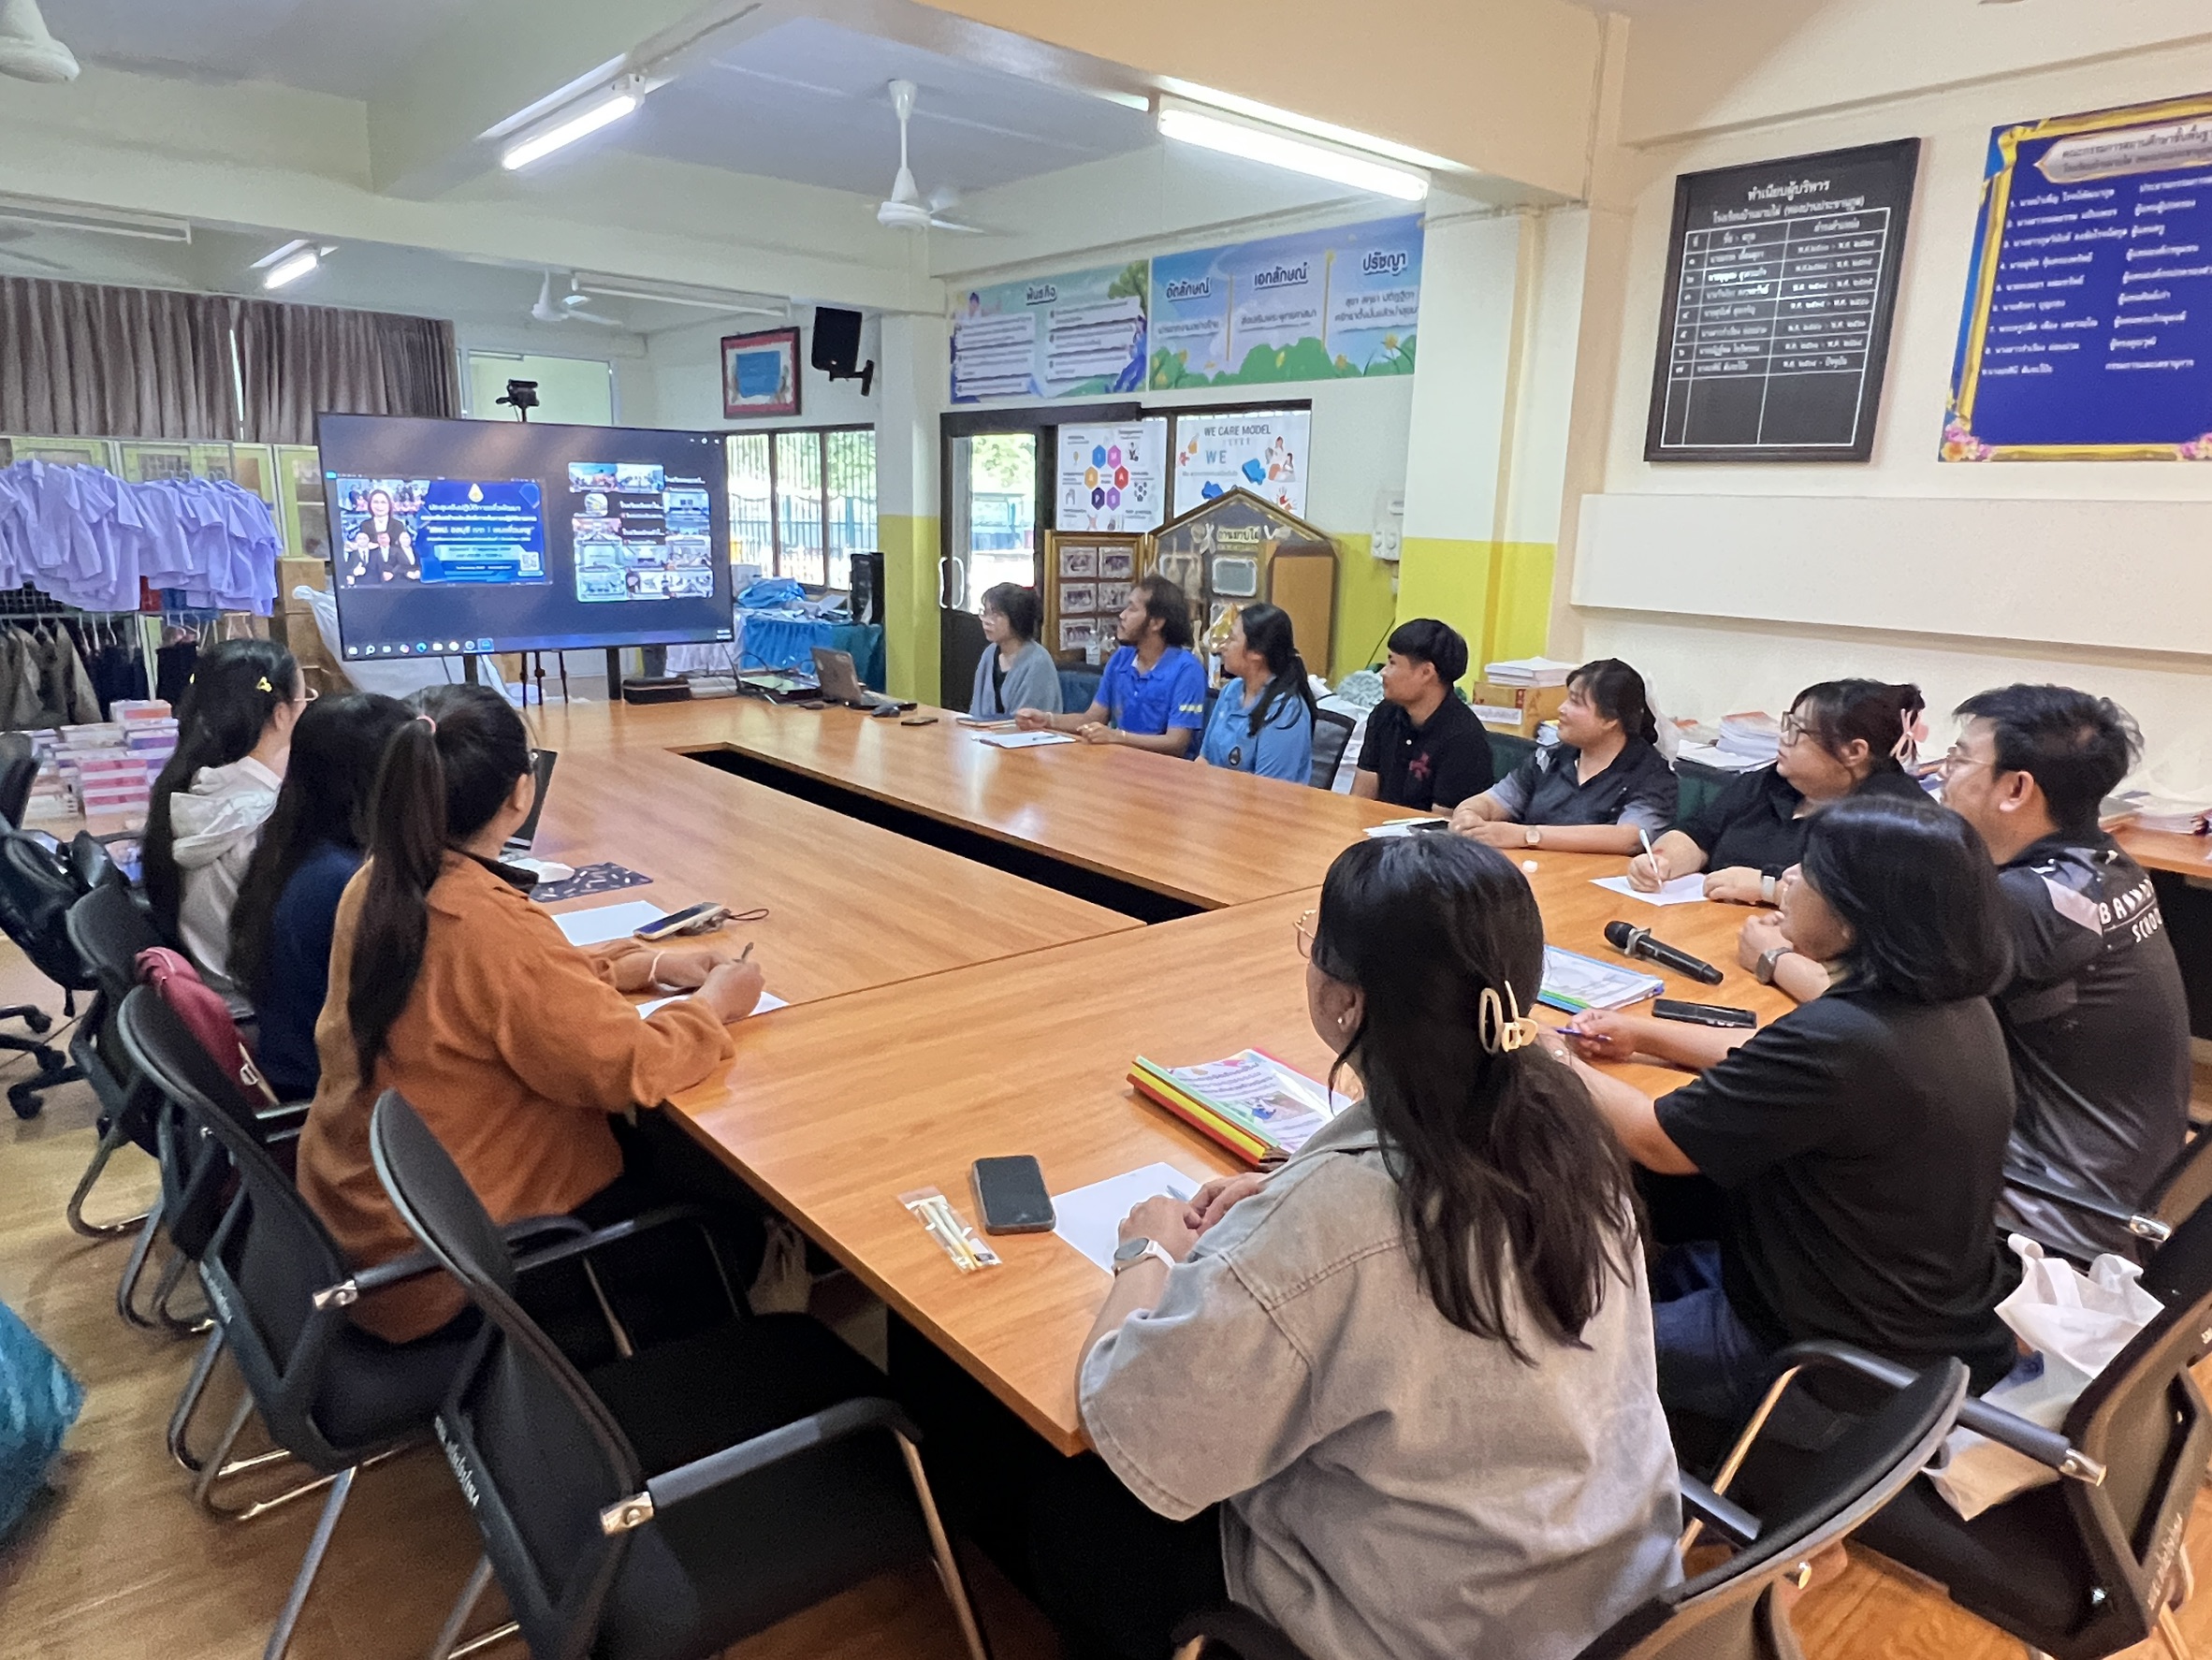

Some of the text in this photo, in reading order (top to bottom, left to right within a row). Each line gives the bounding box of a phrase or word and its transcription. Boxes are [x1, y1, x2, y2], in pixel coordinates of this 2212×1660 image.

[1748, 179, 1831, 201] ทำเนียบผู้บริหาร
[1362, 251, 1406, 271] ปรัชญา
[1254, 262, 1308, 286] เอกลักษณ์
[1166, 277, 1211, 299] อัตลักษณ์
[1204, 424, 1272, 436] WE CARE MODEL
[1205, 449, 1227, 464] WE
